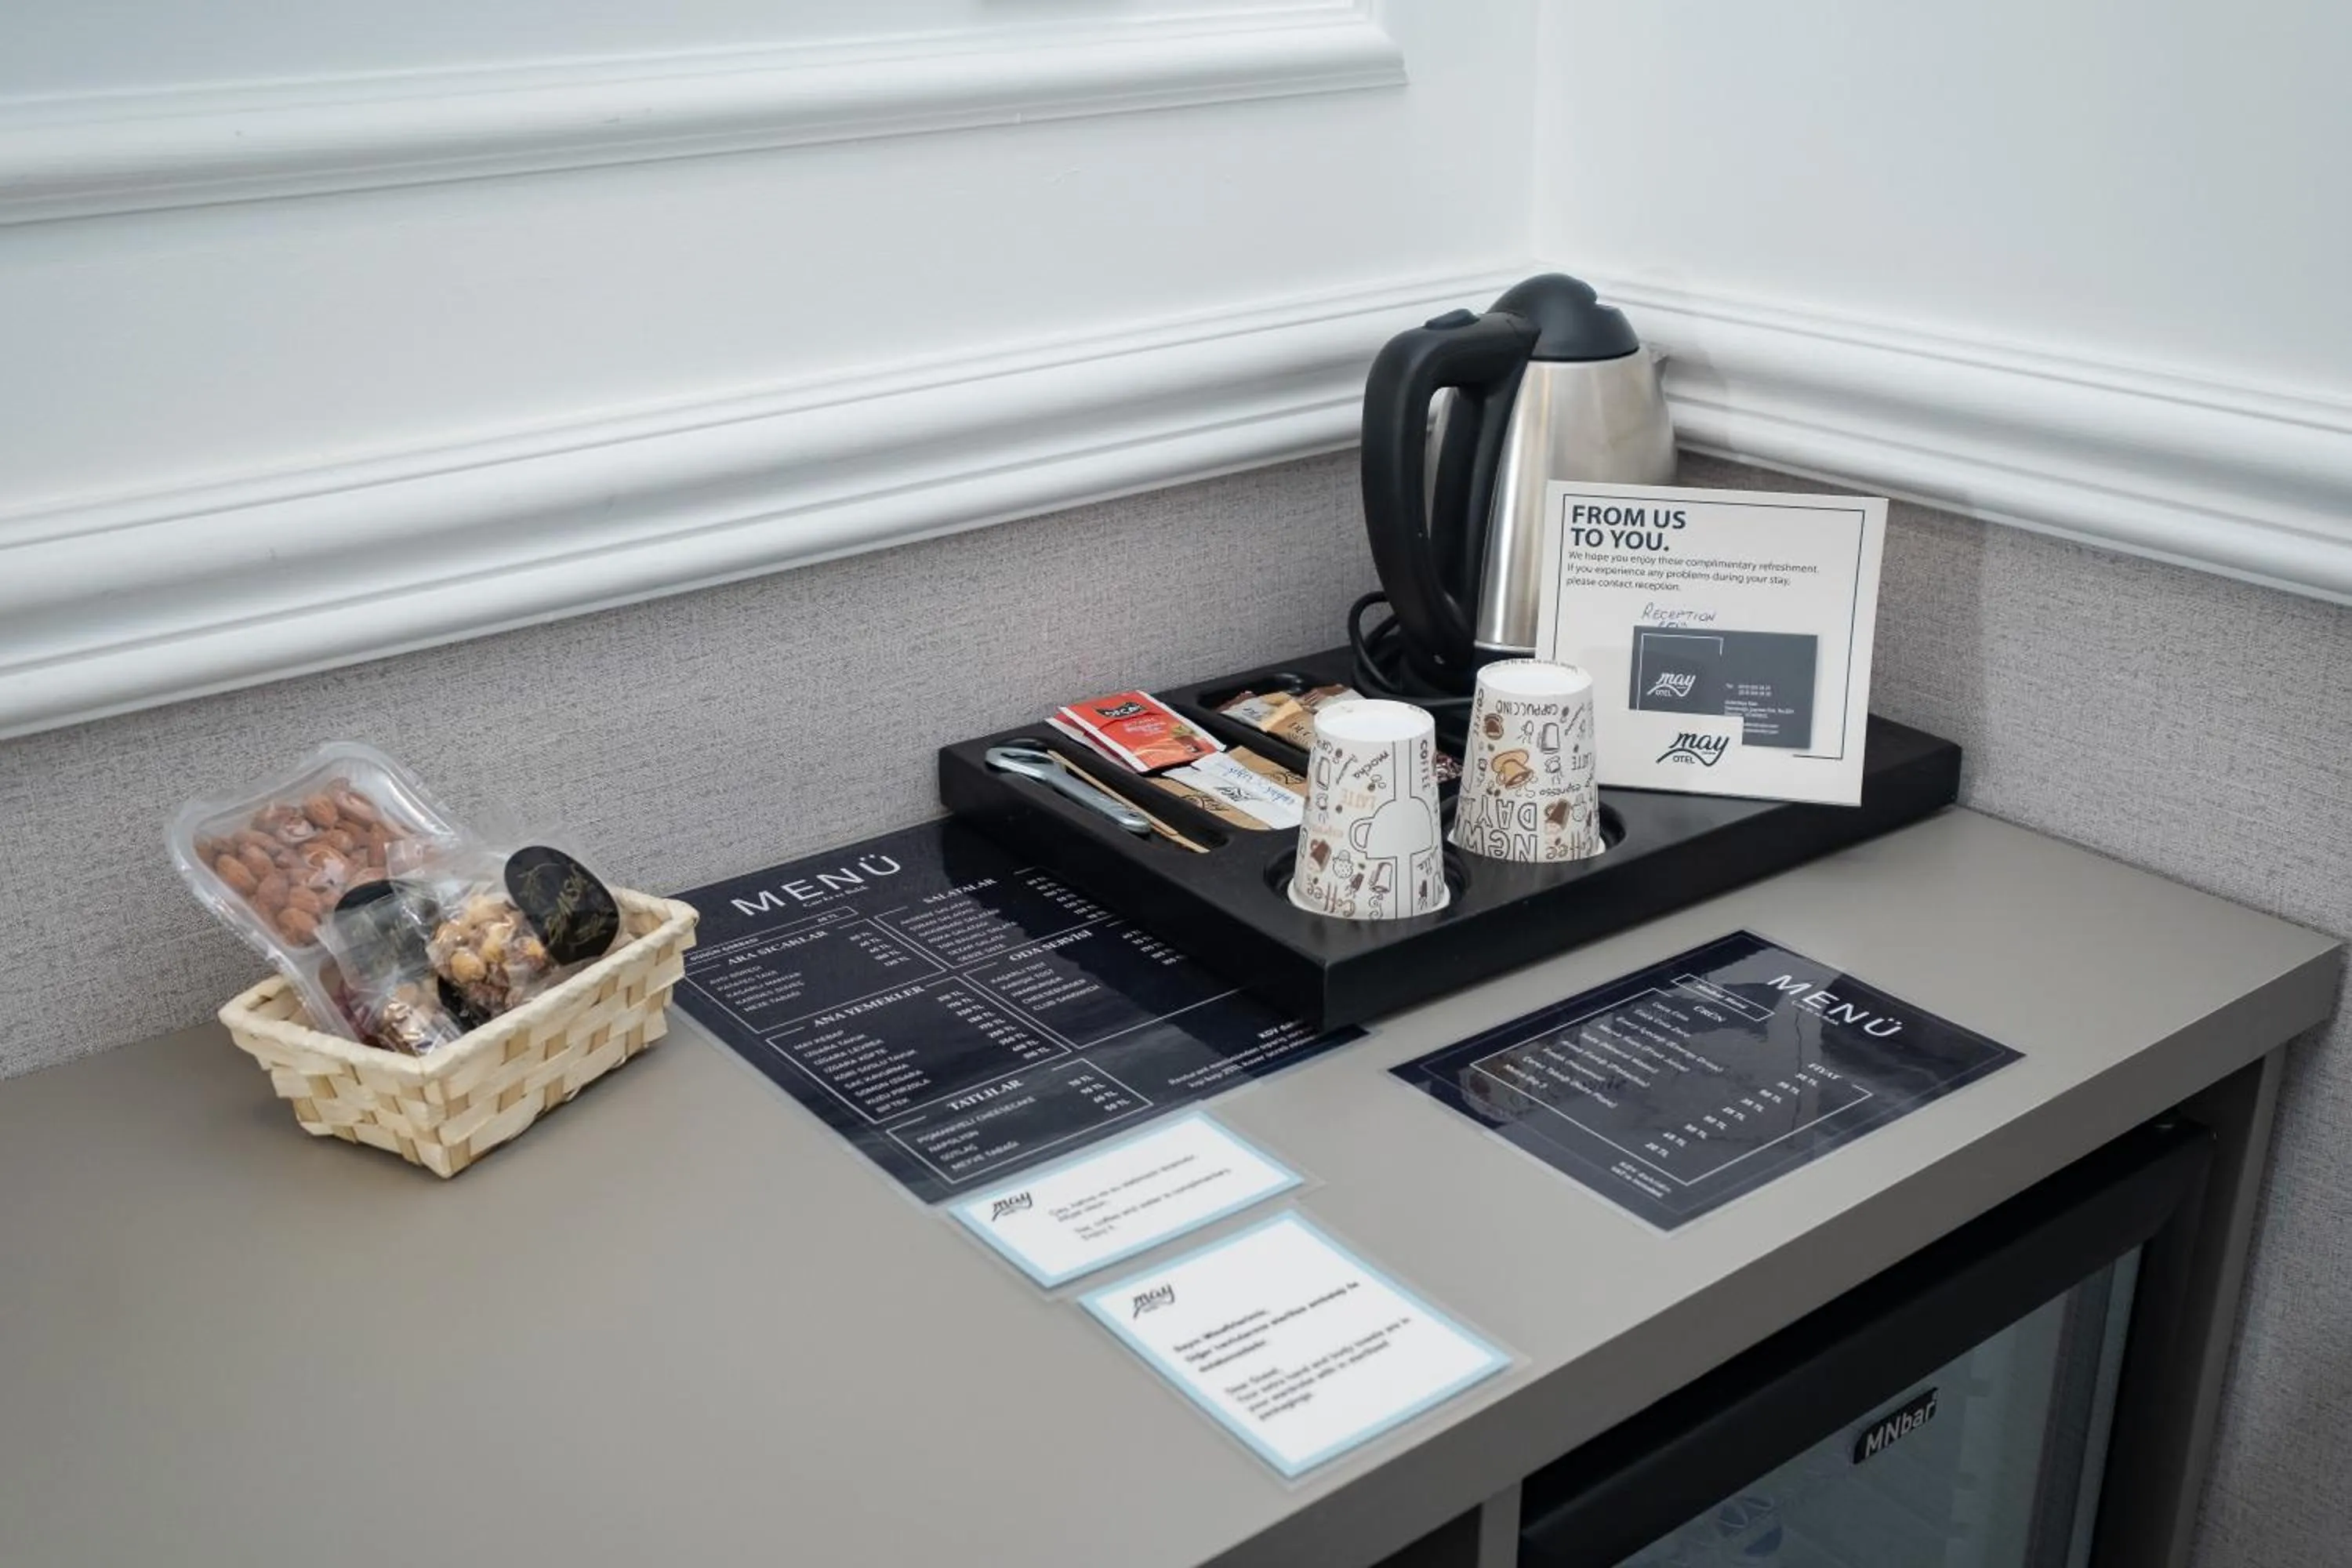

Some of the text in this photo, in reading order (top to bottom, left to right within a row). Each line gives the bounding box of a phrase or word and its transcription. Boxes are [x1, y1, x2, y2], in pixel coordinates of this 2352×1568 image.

[1572, 505, 1686, 529] FROM US
[1570, 528, 1669, 552] TO YOU.
[1584, 552, 1609, 561] hope
[1611, 554, 1628, 563] you
[1630, 554, 1656, 564] enjoy
[1658, 555, 1683, 564] these
[1566, 576, 1596, 587] please
[1599, 579, 1633, 589] contact
[1576, 565, 1592, 574] you
[1595, 566, 1645, 576] experience
[1648, 570, 1664, 579] any
[1712, 570, 1744, 584] during
[1747, 575, 1766, 585] your
[1651, 672, 1697, 697] may
[1661, 732, 1730, 767] may
[1672, 756, 1696, 764] OTEL
[1475, 795, 1537, 832] DAY
[731, 854, 901, 916] MENÜ
[1009, 948, 1043, 961] ODA
[814, 985, 925, 1027] ANA YEMEKLER
[1767, 975, 1903, 1036] MENÜ
[991, 1191, 1033, 1221] may
[1132, 1284, 1175, 1319] may
[1865, 1399, 1936, 1458] MNbar
